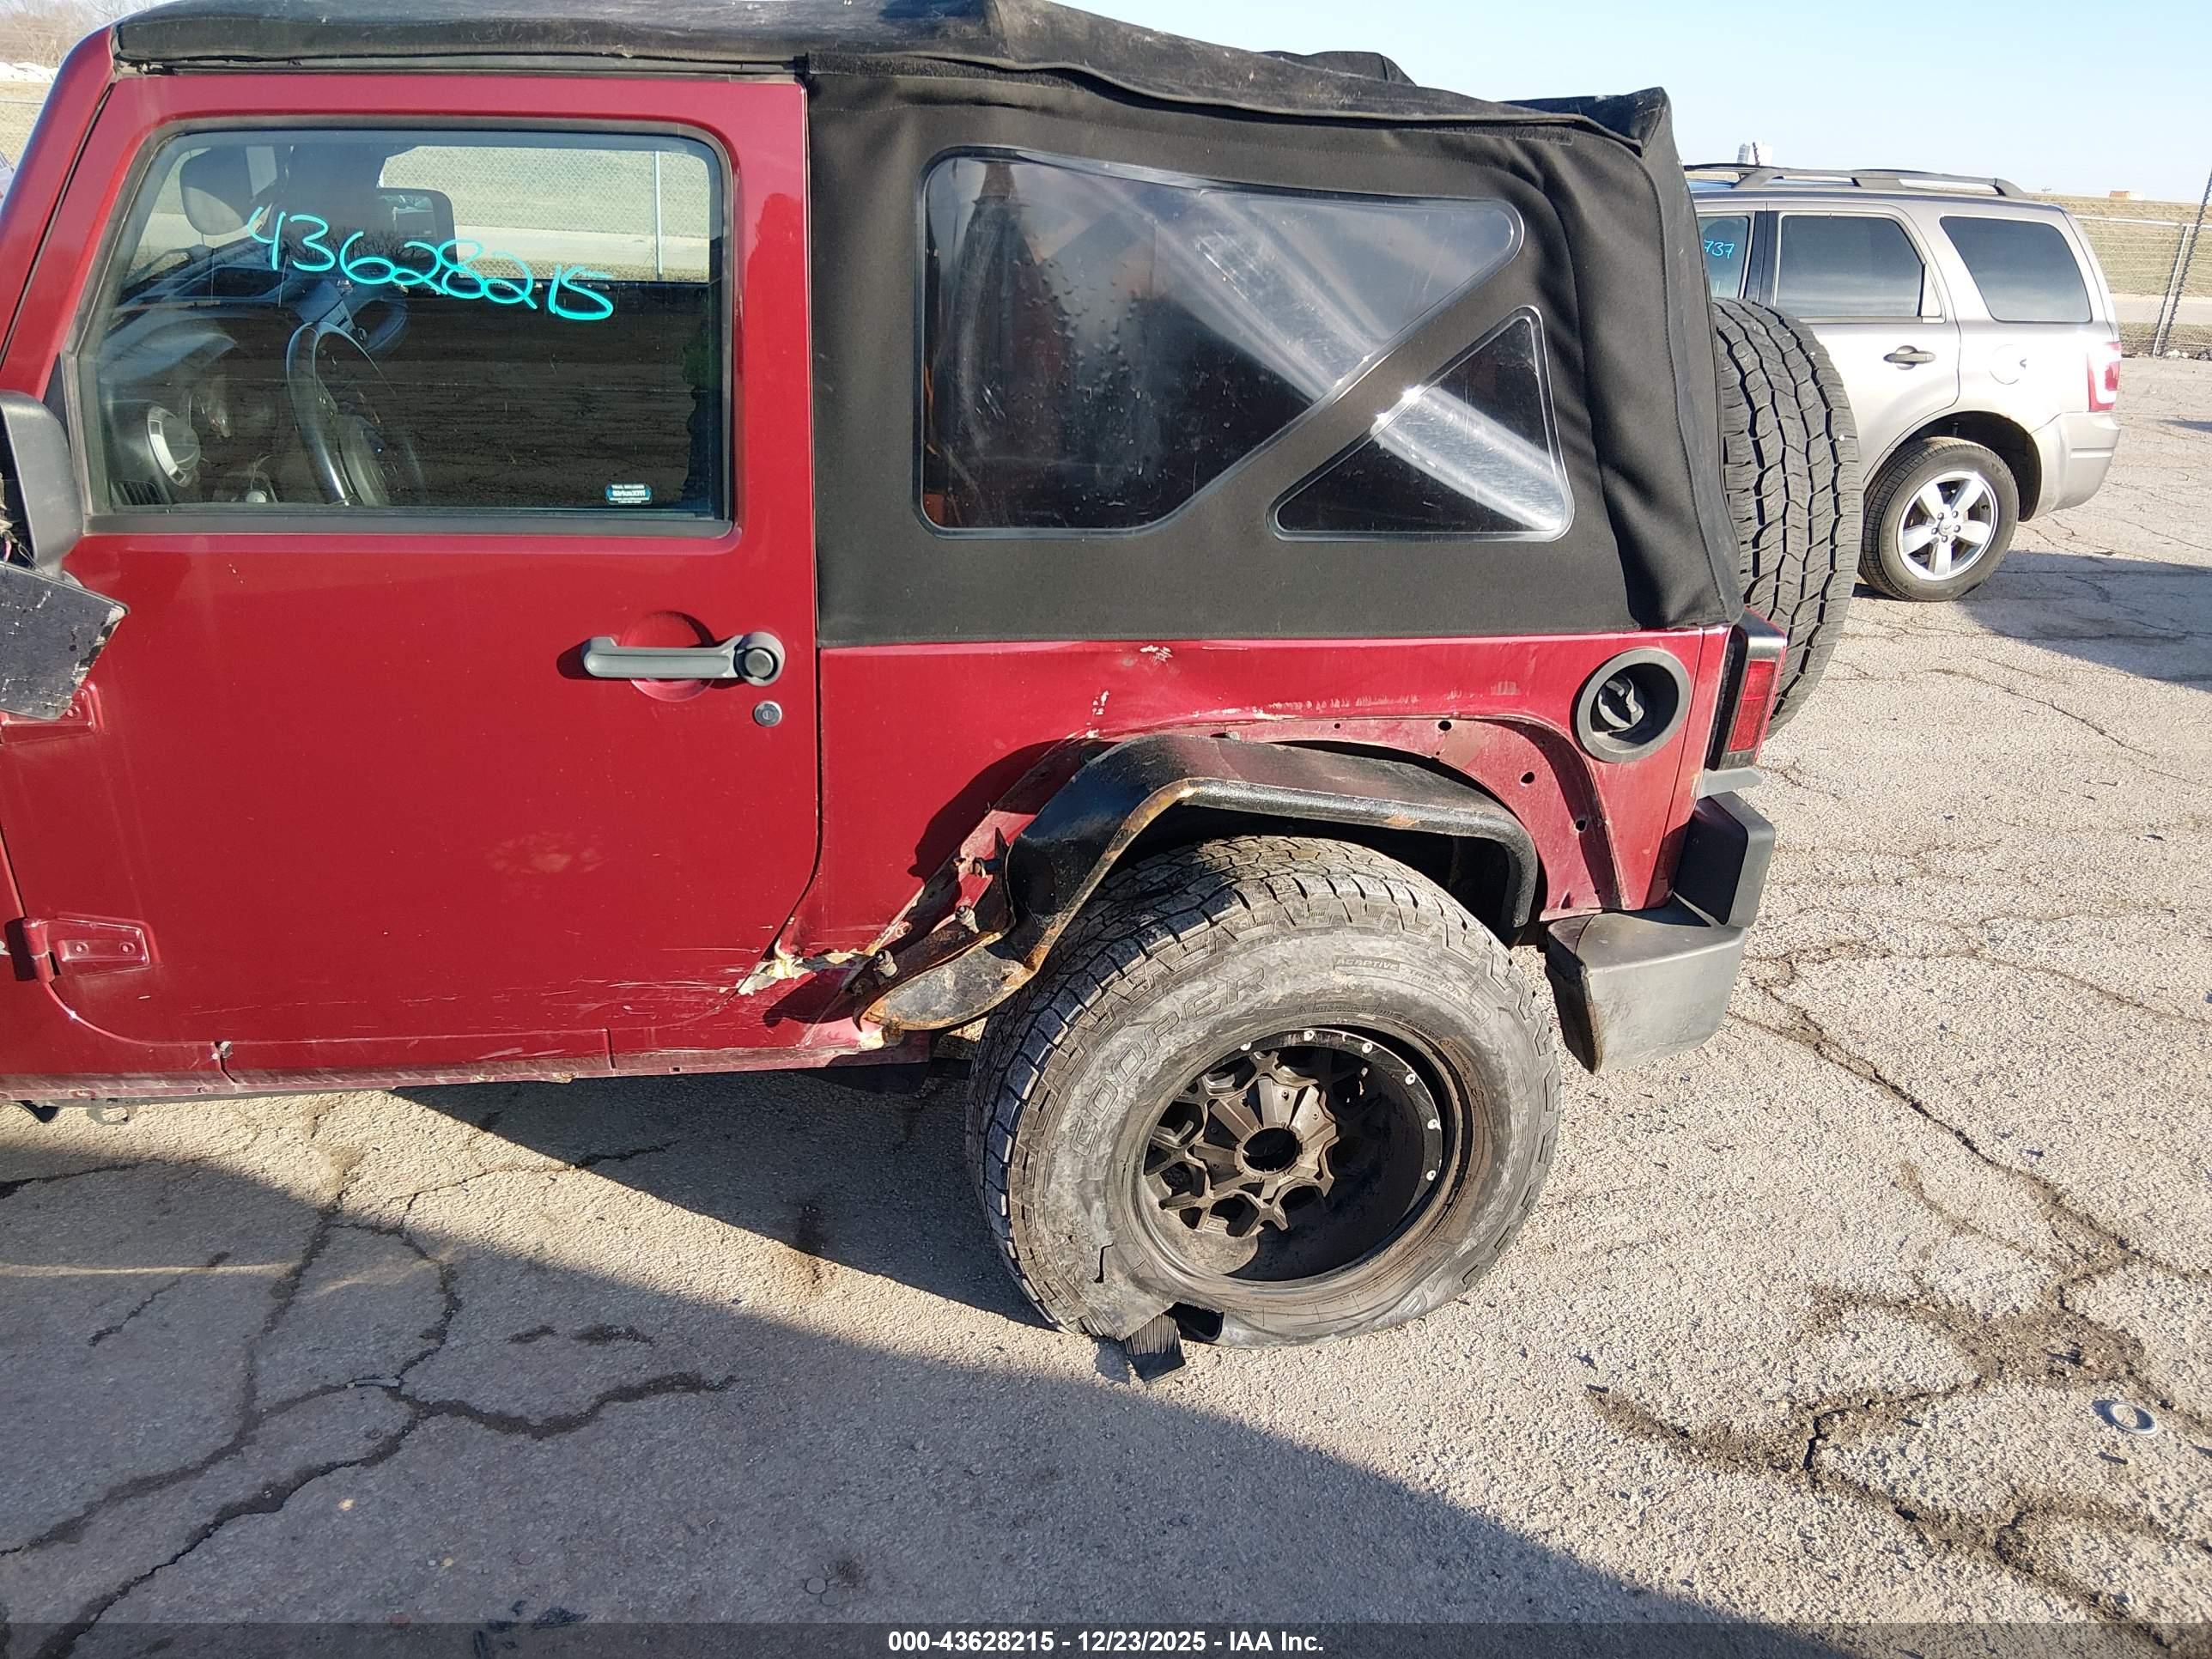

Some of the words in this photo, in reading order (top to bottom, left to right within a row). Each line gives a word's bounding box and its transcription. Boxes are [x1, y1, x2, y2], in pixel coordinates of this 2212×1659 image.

[247, 207, 613, 320] 43628215
[1704, 239, 1735, 259] 737
[1335, 957, 1400, 971] ADAPTIVE
[1069, 966, 1267, 1157] COOPER
